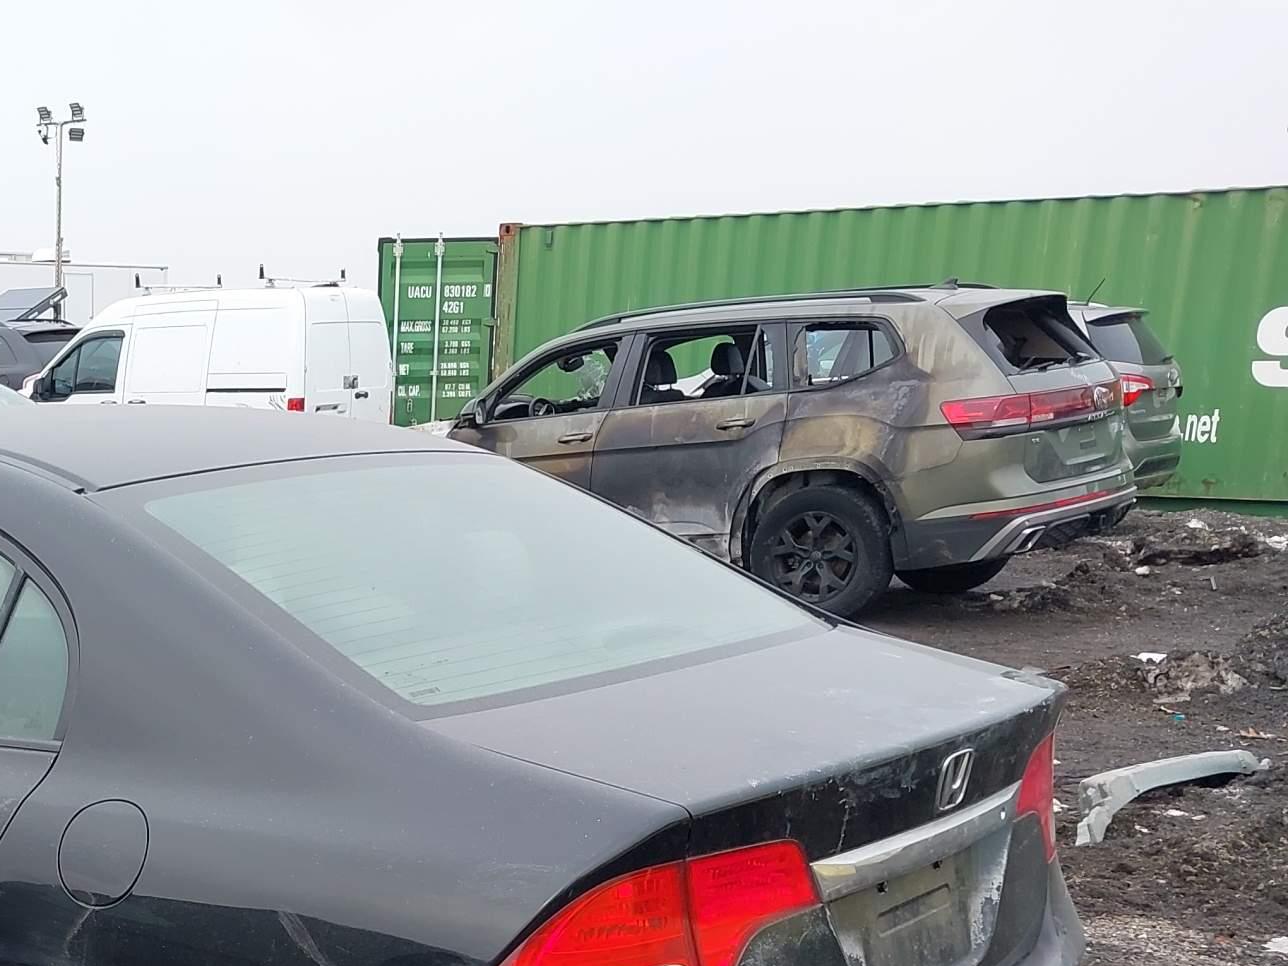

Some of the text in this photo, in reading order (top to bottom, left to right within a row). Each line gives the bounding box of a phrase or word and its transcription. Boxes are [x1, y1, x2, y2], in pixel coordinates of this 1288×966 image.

[408, 286, 432, 298] UACU
[444, 285, 477, 298] 830182
[442, 301, 464, 313] 42G1
[400, 342, 414, 354] TARE
